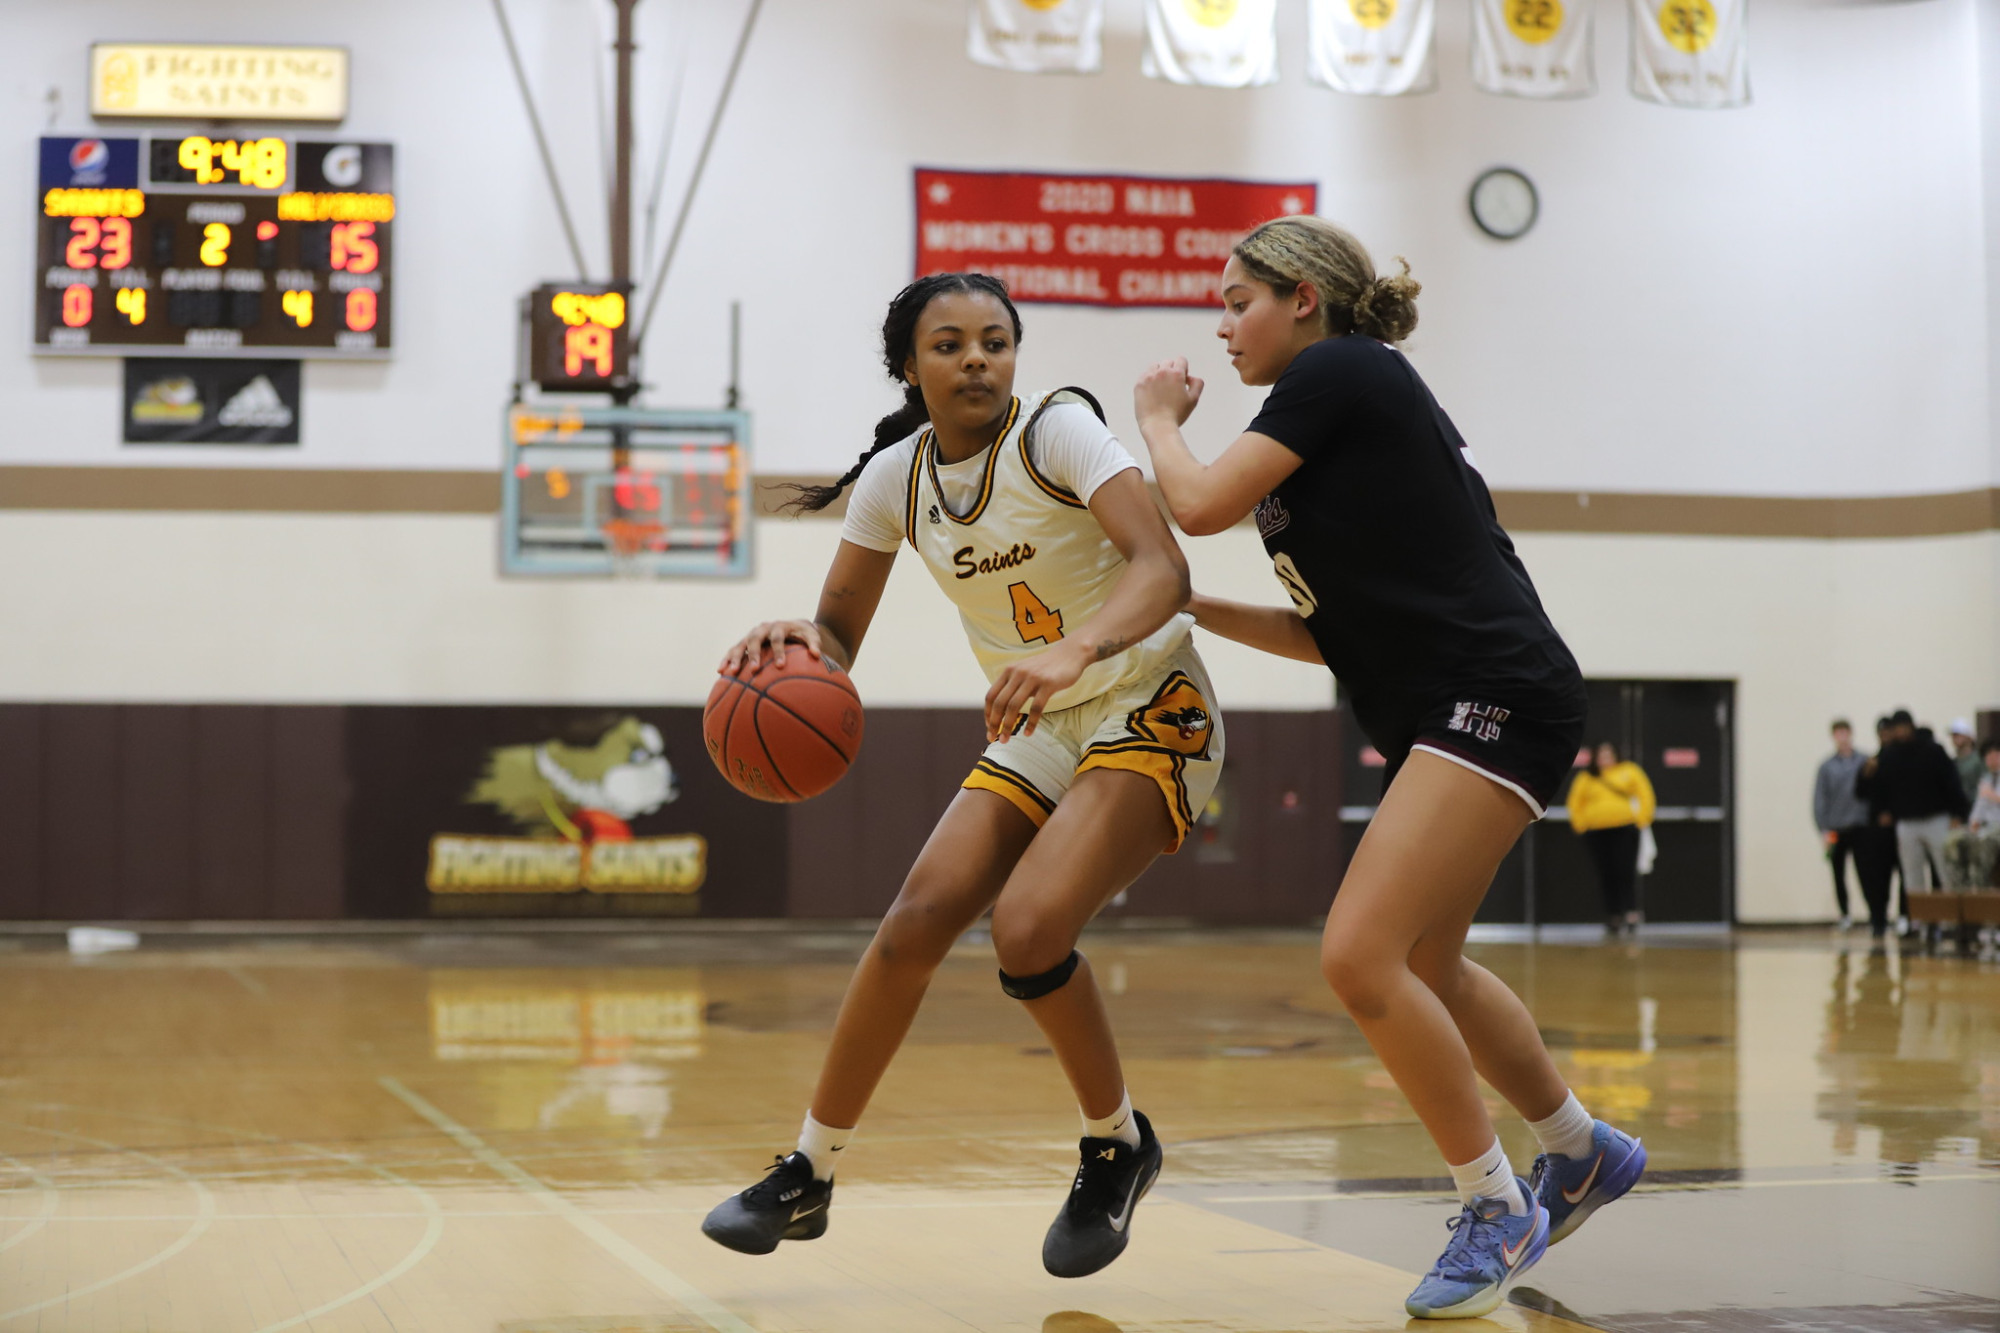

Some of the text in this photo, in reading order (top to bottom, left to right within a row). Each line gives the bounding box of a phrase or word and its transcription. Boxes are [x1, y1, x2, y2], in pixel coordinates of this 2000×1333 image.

[145, 54, 334, 79] FIGHTING
[168, 84, 310, 105] SAINTS
[178, 136, 287, 189] 9:48
[1038, 181, 1195, 217] 2020 NAIA
[66, 216, 132, 270] 23
[199, 222, 231, 267] 2
[330, 220, 379, 274] 15
[922, 220, 1055, 253] WOMEN'S
[1064, 224, 1164, 258] CROSS
[62, 284, 93, 328] 0
[116, 287, 146, 325] 4
[282, 290, 313, 328] 4
[345, 288, 377, 332] 0
[565, 323, 613, 377] 19
[953, 543, 1036, 580] Saints
[1007, 580, 1065, 645] 4
